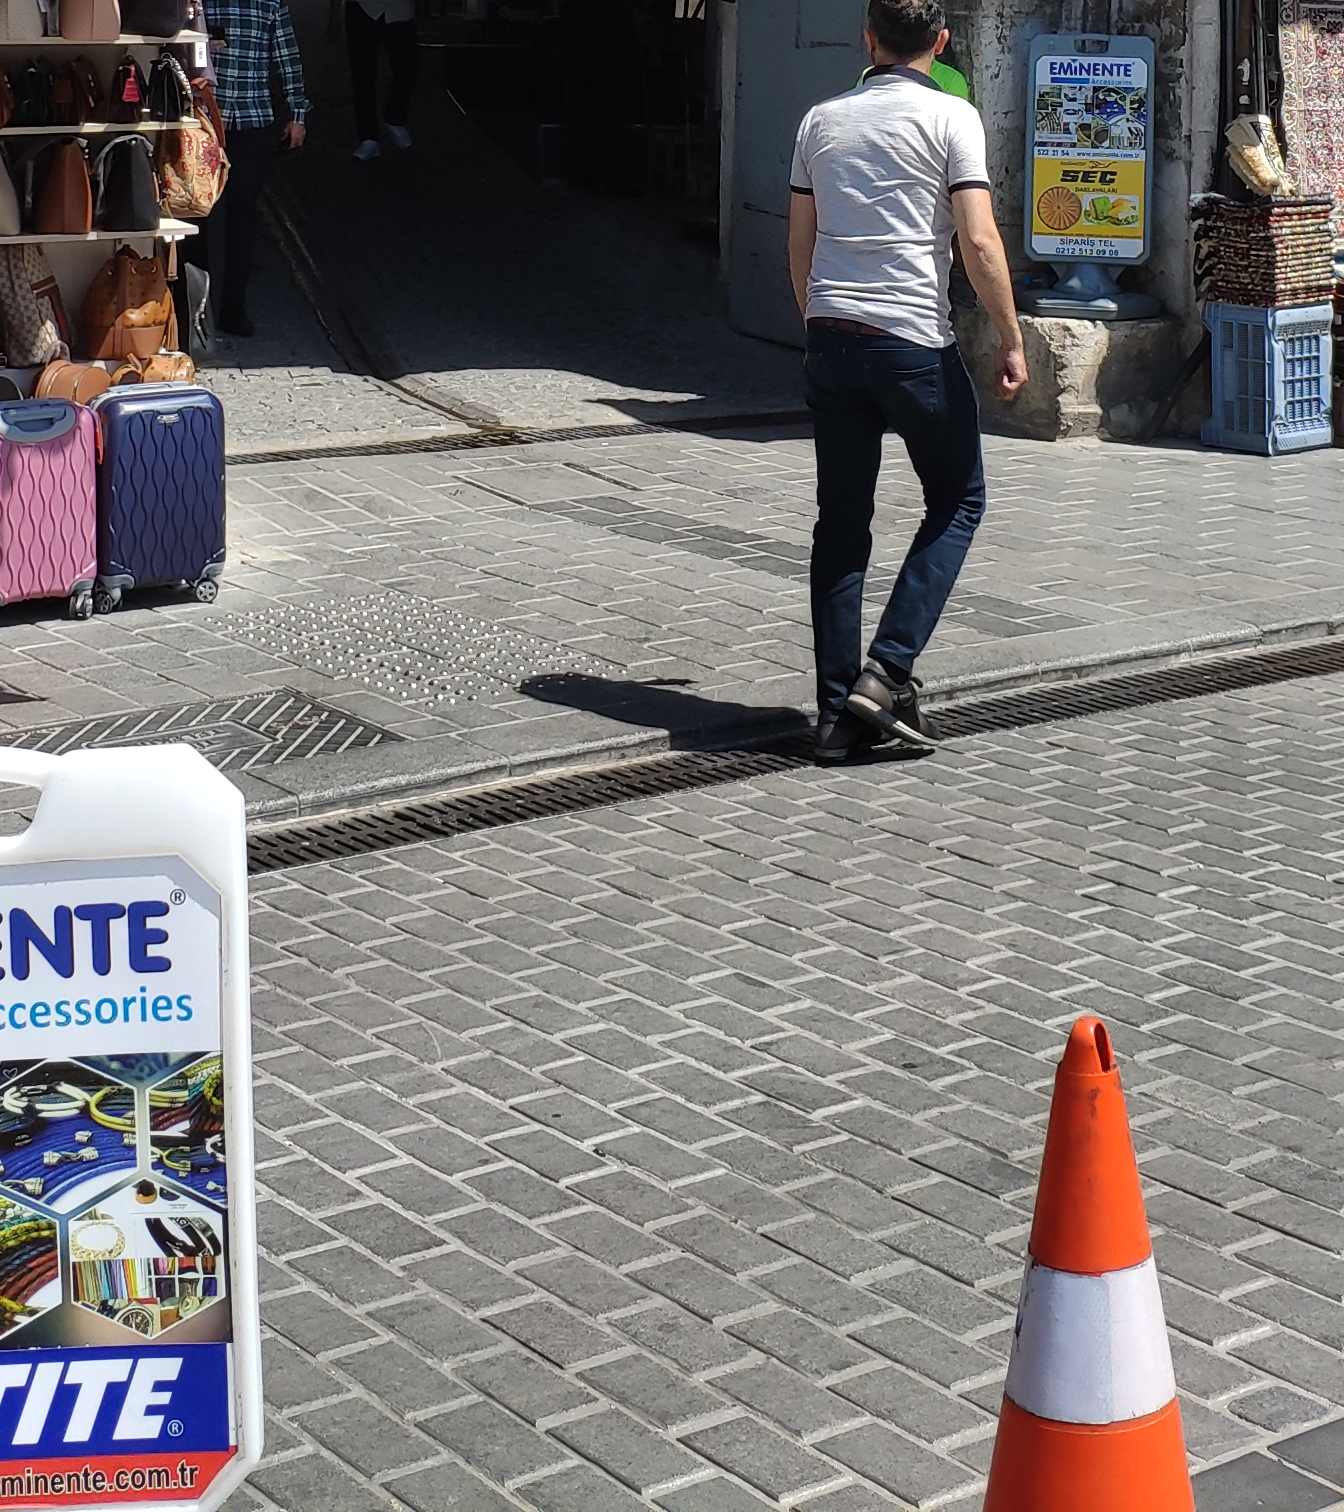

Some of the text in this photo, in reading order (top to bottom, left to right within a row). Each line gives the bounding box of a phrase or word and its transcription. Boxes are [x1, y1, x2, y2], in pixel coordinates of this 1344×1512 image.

[1059, 237, 1116, 247] SİPARİŞ TEL
[1055, 247, 1076, 255] 0212
[1078, 248, 1094, 256] 513
